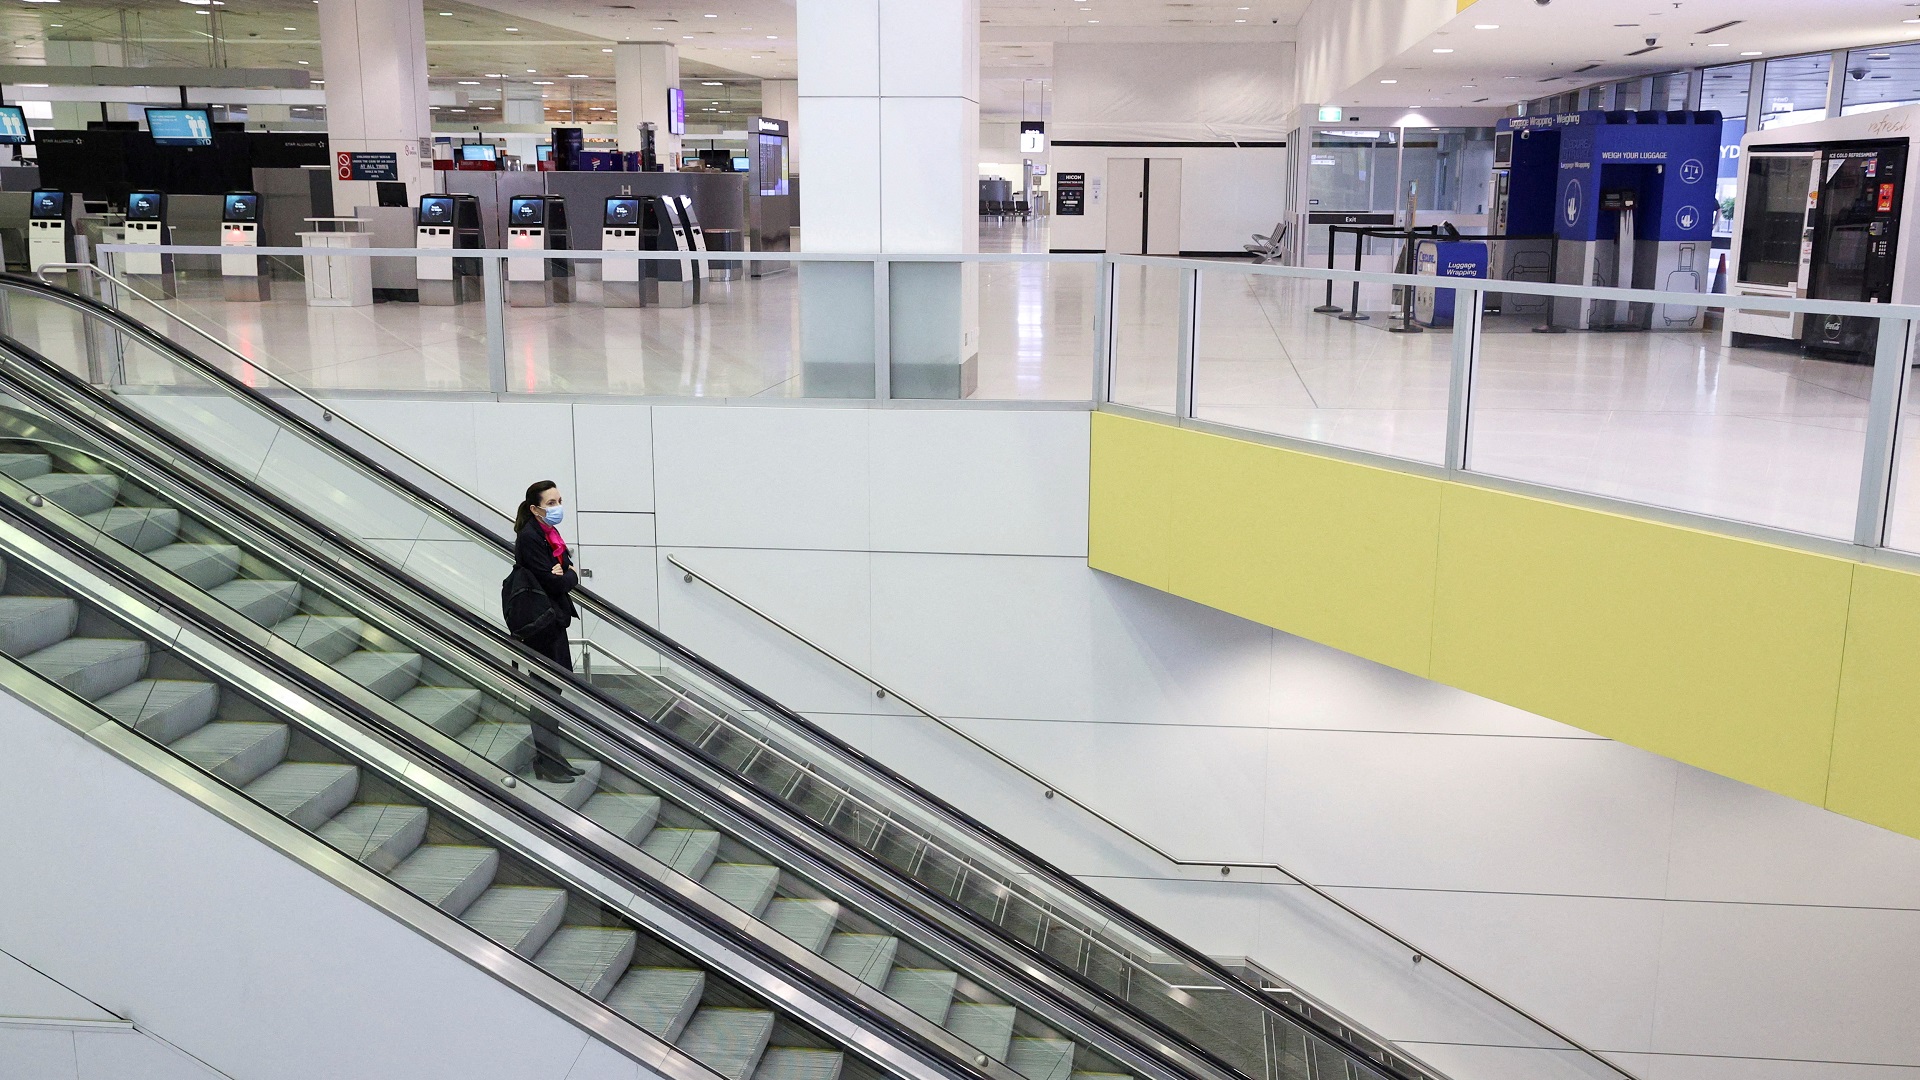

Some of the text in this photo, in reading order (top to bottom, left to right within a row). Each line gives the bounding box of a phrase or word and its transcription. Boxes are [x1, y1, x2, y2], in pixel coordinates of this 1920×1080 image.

[1509, 118, 1529, 128] Luggage
[1530, 116, 1553, 127] Wrapping
[1557, 113, 1580, 125] Weighing
[1867, 114, 1912, 135] refresh
[1030, 137, 1035, 149] J
[621, 185, 631, 195] H
[1448, 262, 1476, 270] Luggage
